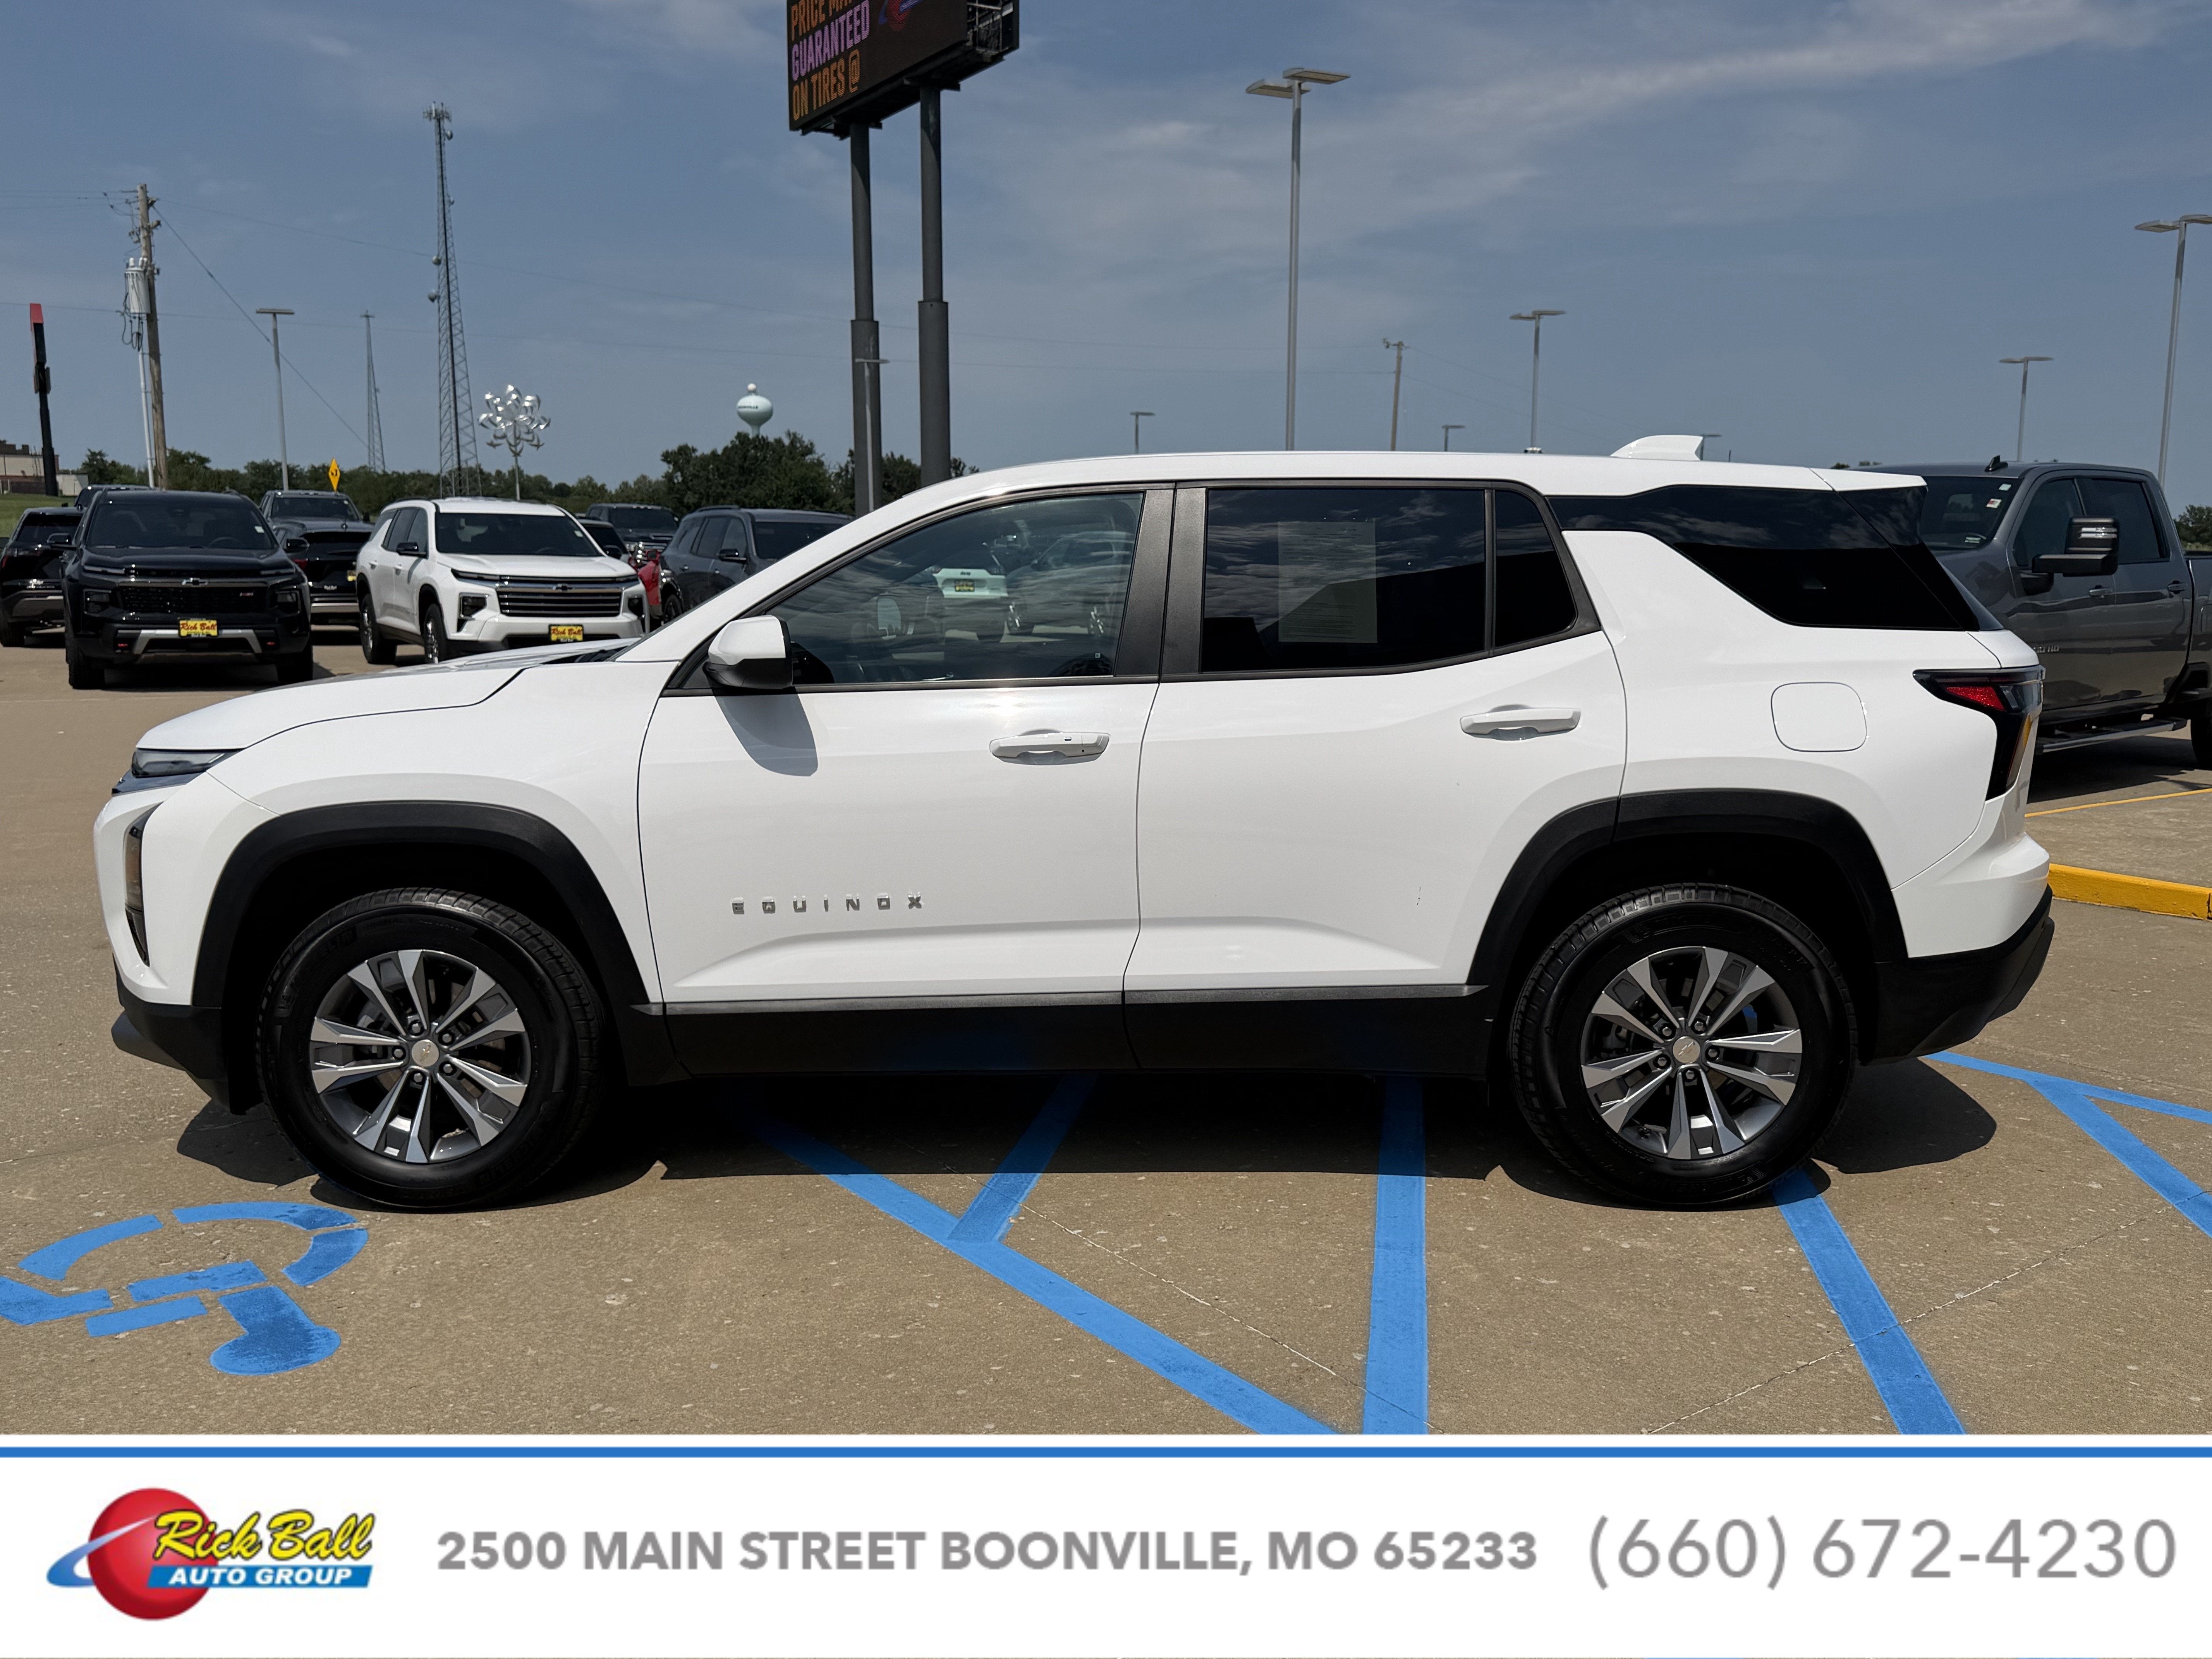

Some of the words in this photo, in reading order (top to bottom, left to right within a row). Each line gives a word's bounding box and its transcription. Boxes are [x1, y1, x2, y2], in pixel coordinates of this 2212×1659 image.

[792, 0, 826, 41] PRICE
[792, 0, 870, 81] GUARANTEED
[793, 79, 808, 121] ON
[811, 58, 845, 110] TIRES
[848, 49, 860, 93] @
[732, 891, 922, 915] EQUINOX
